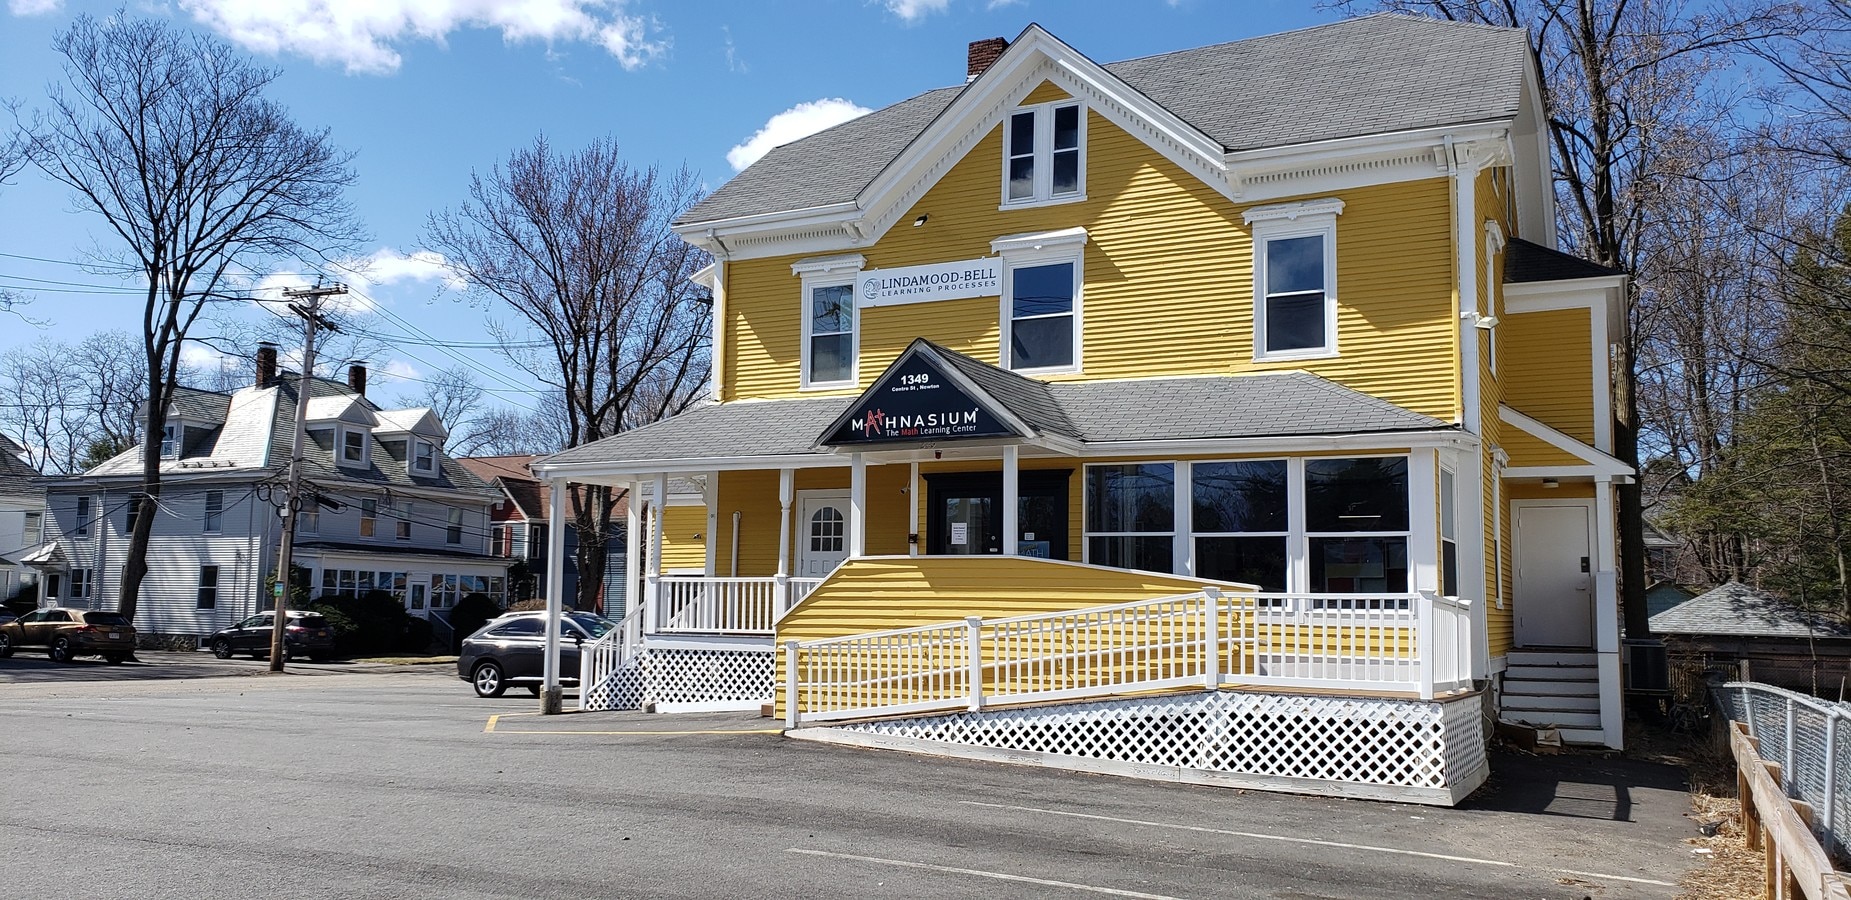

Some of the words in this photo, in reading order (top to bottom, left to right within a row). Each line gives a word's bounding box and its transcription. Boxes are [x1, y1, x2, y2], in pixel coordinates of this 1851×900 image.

[881, 268, 997, 290] LINDAMOOD-BELL
[881, 286, 931, 297] LEARNING
[937, 280, 997, 292] PROCESSES
[900, 373, 929, 385] 1349
[886, 429, 900, 437] The
[901, 427, 919, 436] Math
[920, 425, 951, 435] Learning
[952, 424, 977, 433] Center
